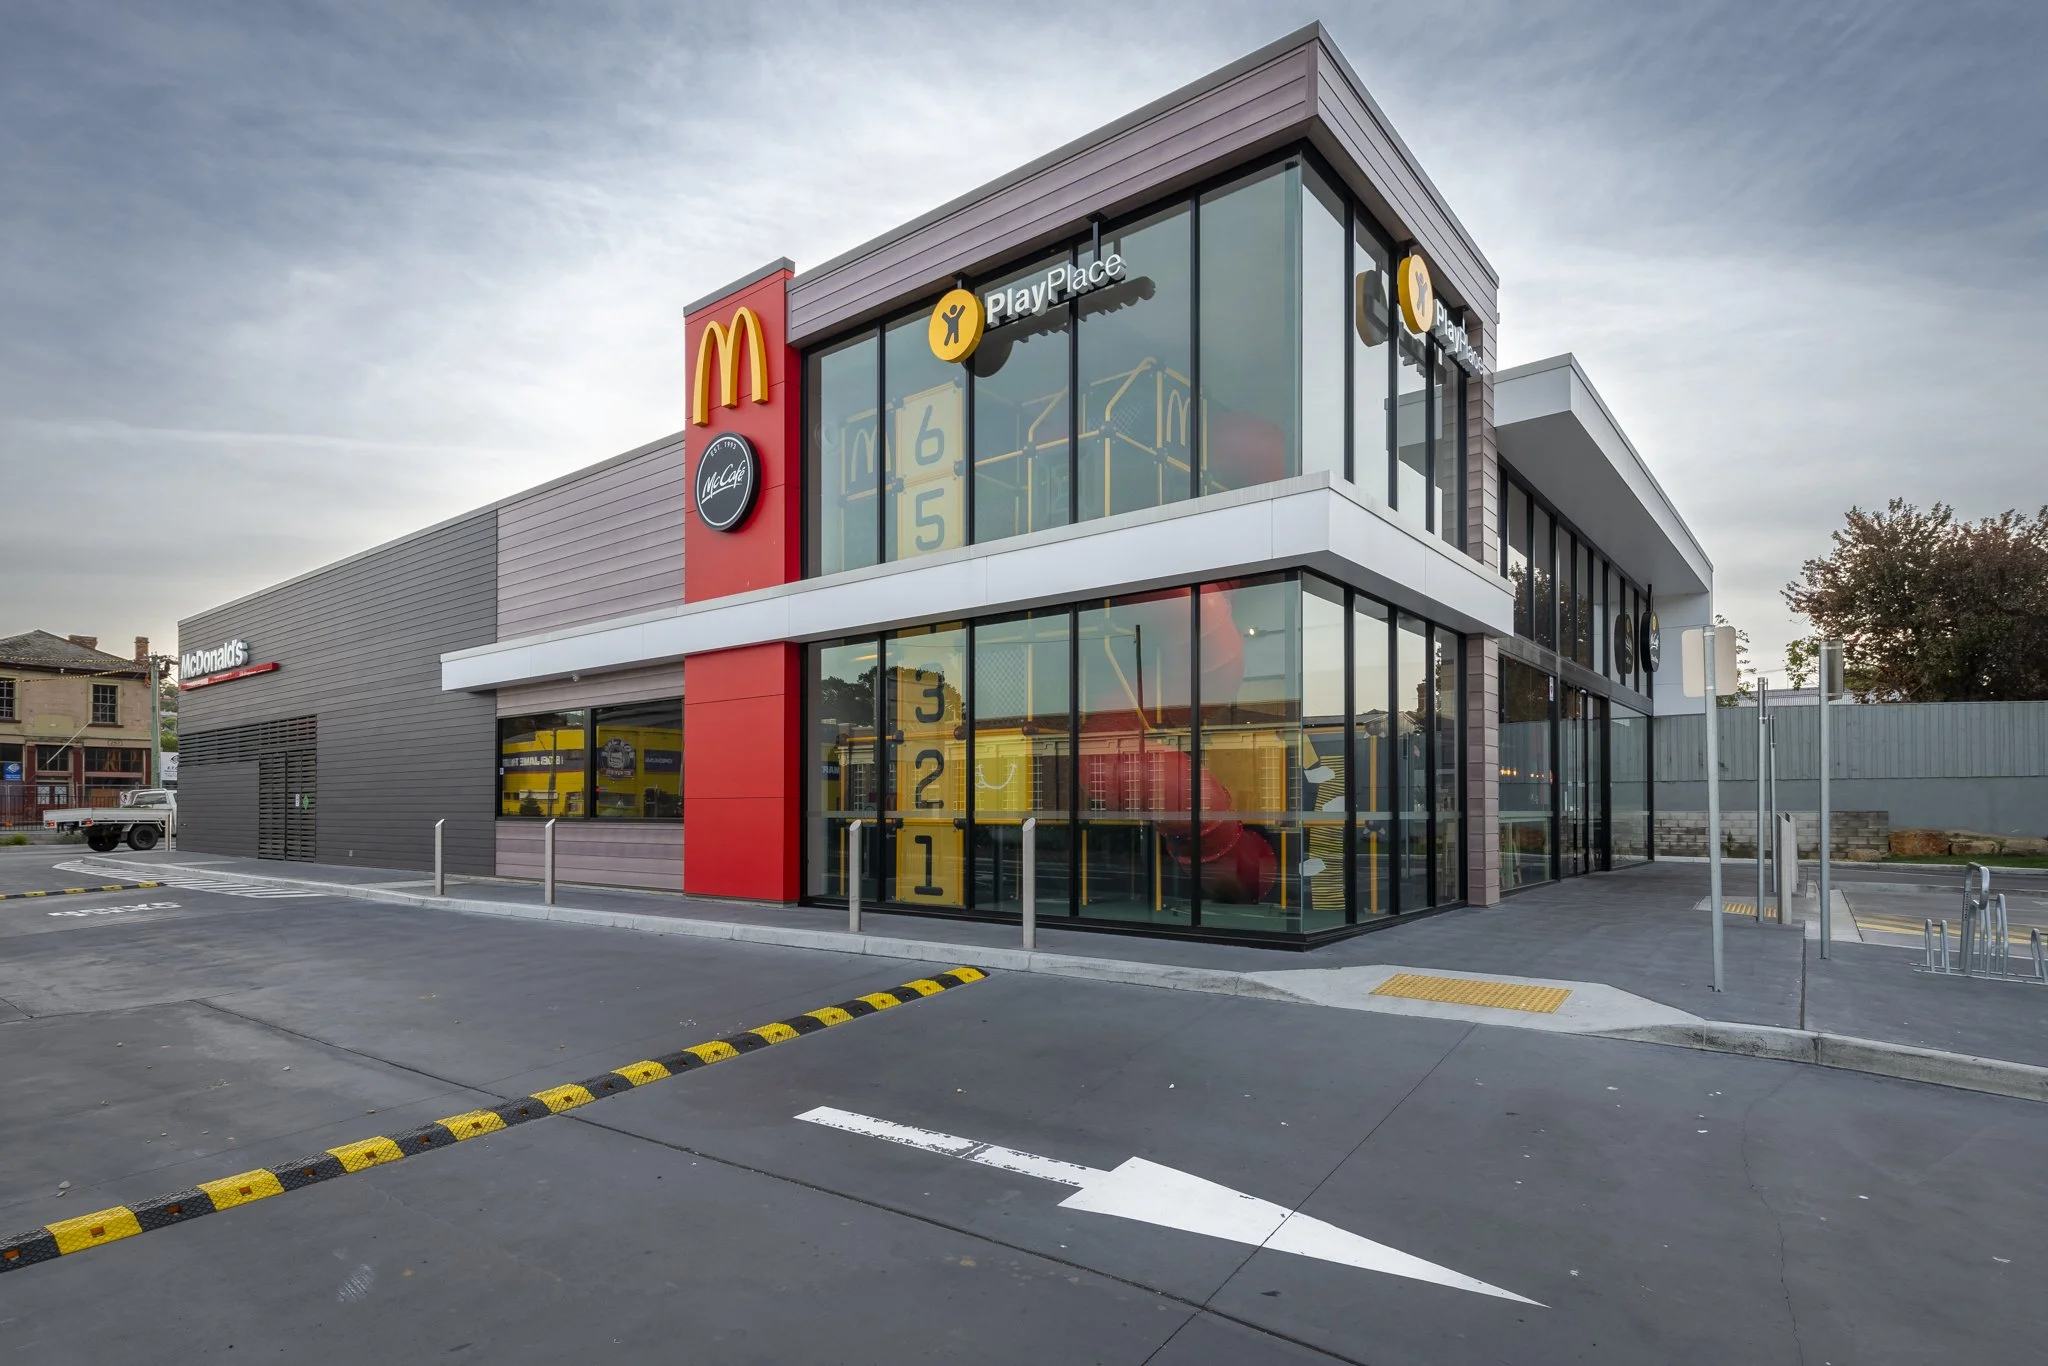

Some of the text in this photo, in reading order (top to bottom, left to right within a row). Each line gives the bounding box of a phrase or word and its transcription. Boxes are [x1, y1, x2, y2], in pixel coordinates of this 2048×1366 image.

[987, 253, 1125, 326] PlayPlace
[914, 404, 946, 466] 6
[701, 459, 747, 501] McCafé
[914, 487, 945, 551] 5
[180, 639, 245, 679] McDonald's
[914, 662, 946, 724] 3
[914, 749, 946, 810] 2
[913, 834, 944, 897] 1
